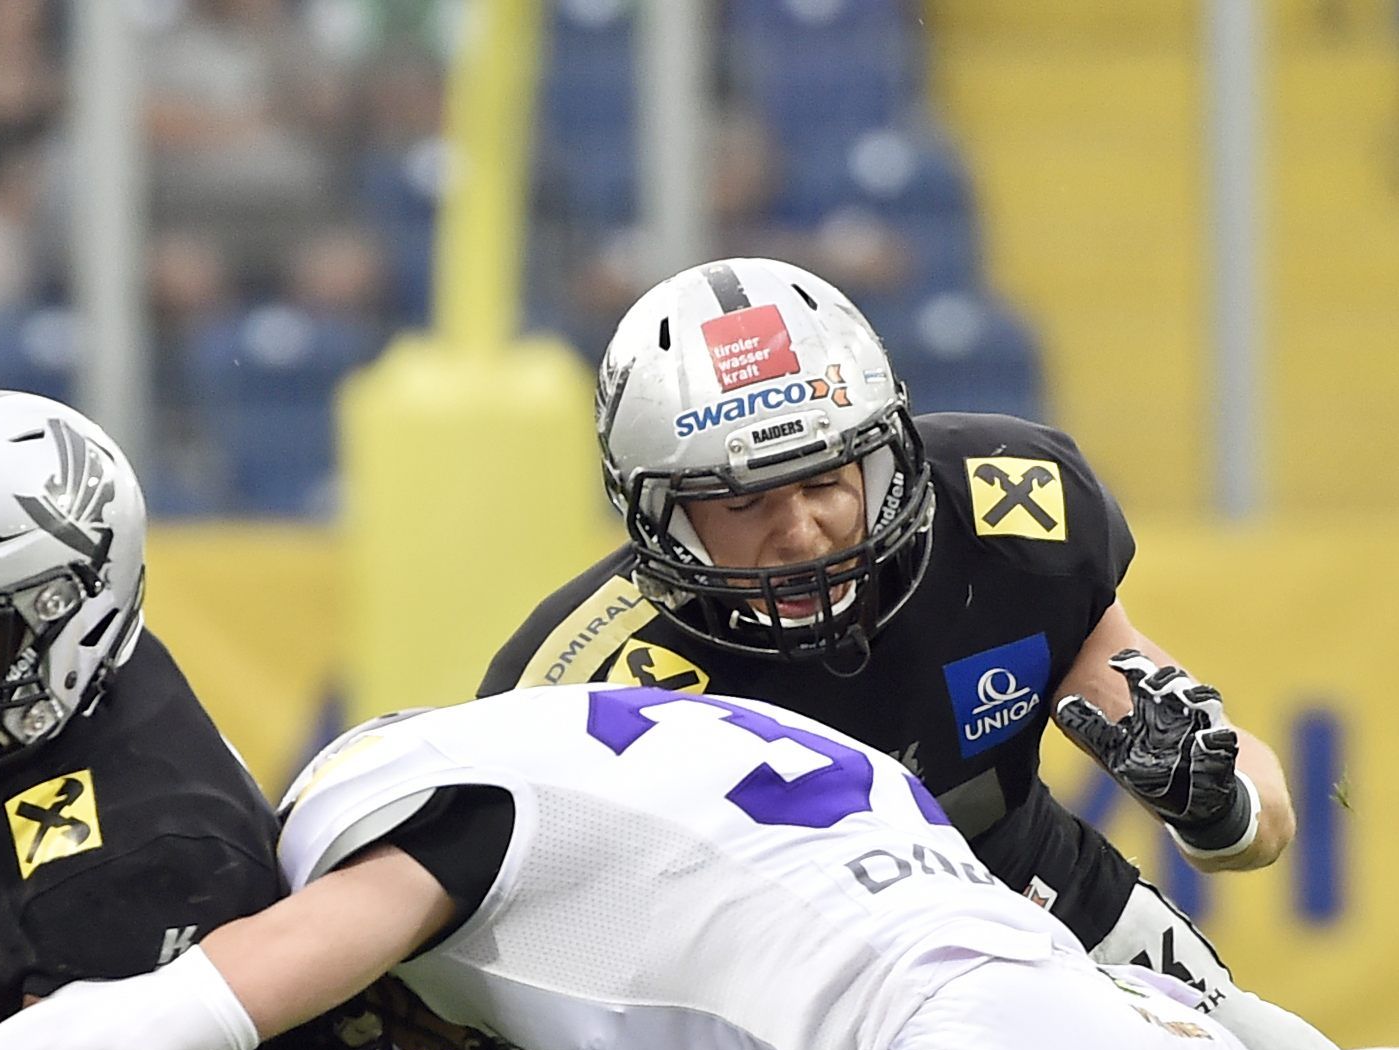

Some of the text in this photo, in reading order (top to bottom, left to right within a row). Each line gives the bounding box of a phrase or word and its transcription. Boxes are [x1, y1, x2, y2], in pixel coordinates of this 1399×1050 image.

[714, 336, 760, 358] tiroler
[719, 348, 771, 371] wasser
[722, 367, 760, 386] kraft
[676, 383, 806, 437] swarco
[752, 420, 804, 444] RAIDERS
[544, 595, 645, 684] DMIRAL
[965, 693, 1040, 740] UNIQA
